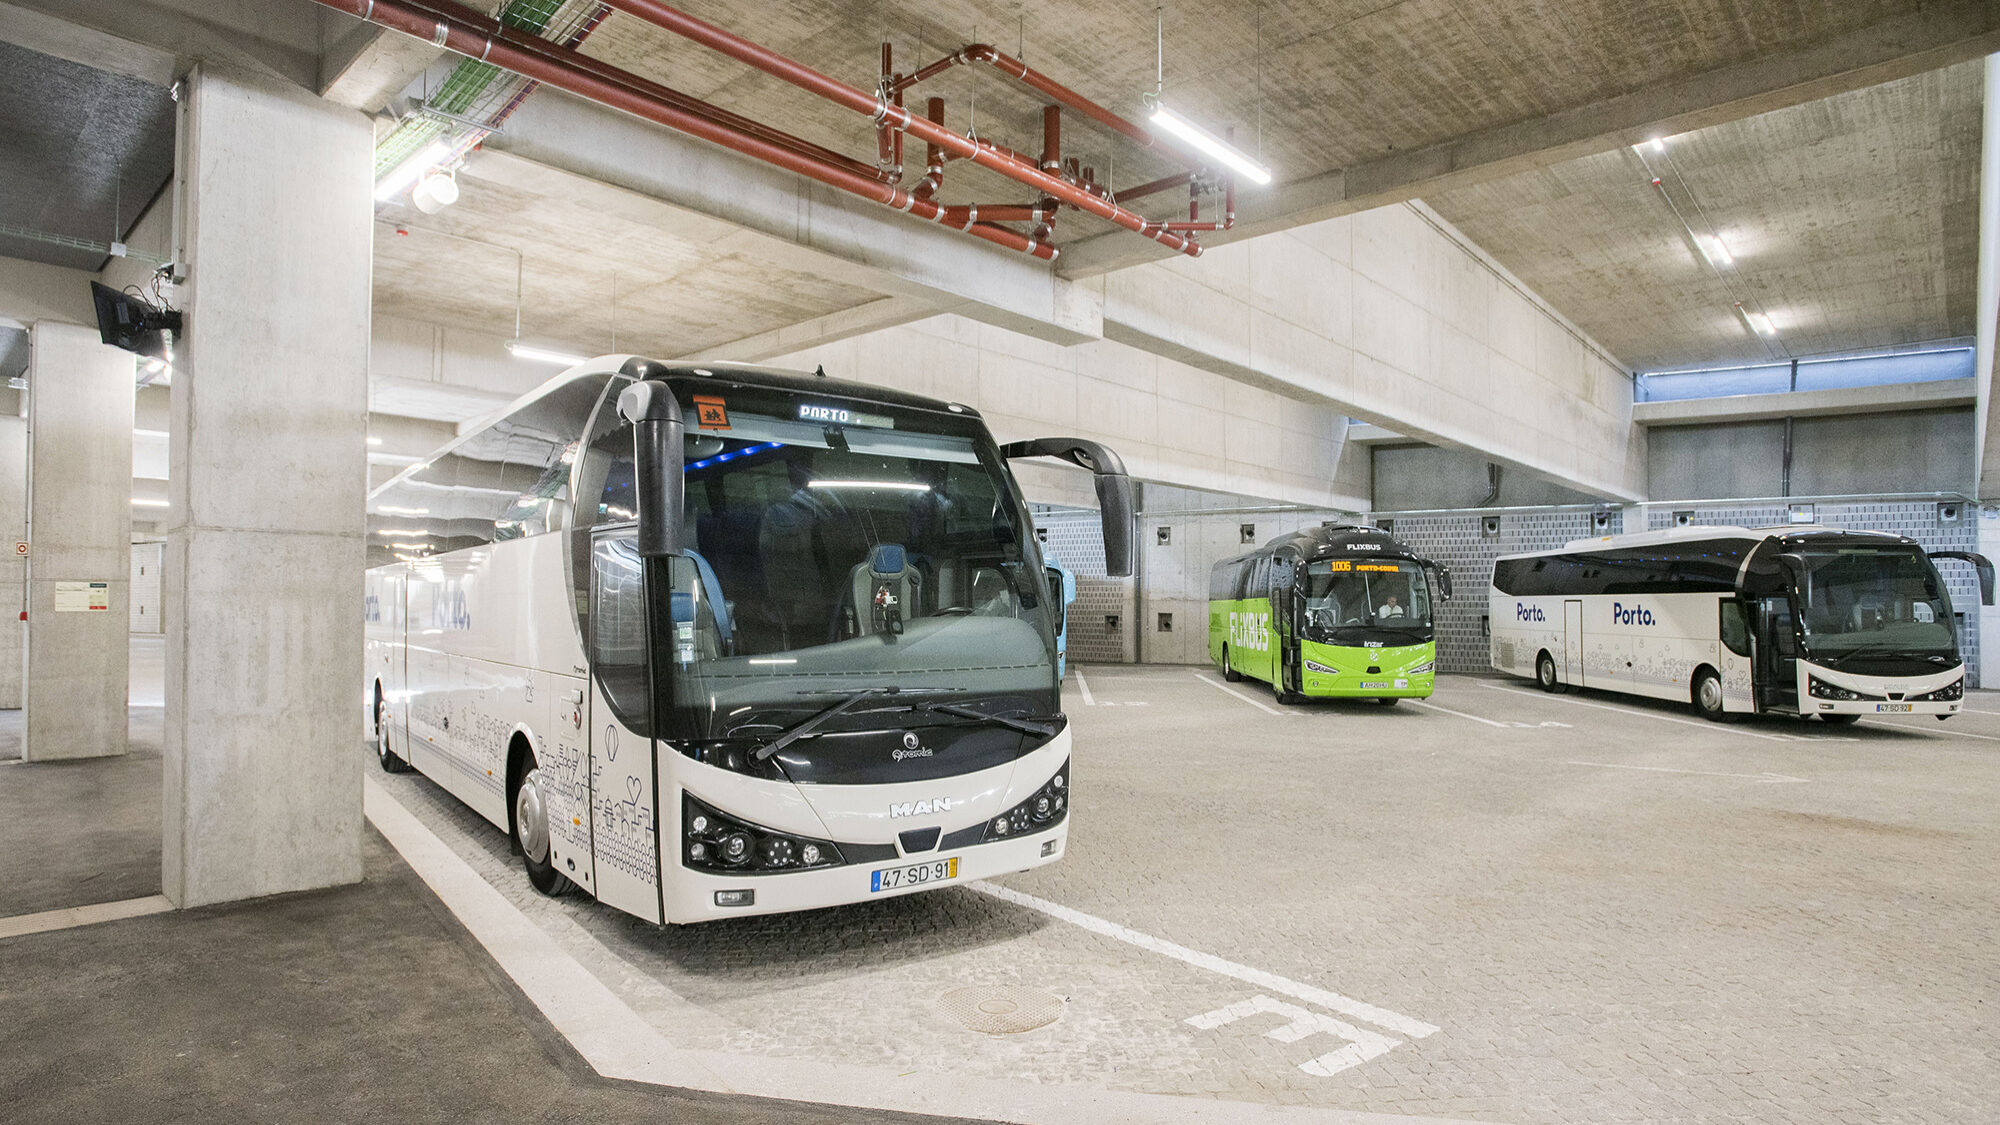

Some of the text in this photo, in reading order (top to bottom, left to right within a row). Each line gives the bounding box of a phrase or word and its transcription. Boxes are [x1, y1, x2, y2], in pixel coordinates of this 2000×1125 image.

[800, 405, 848, 421] PORTO
[1332, 561, 1351, 571] 1006
[1517, 602, 1546, 622] Porto.
[1614, 602, 1656, 626] Porto.
[890, 797, 951, 818] MAN
